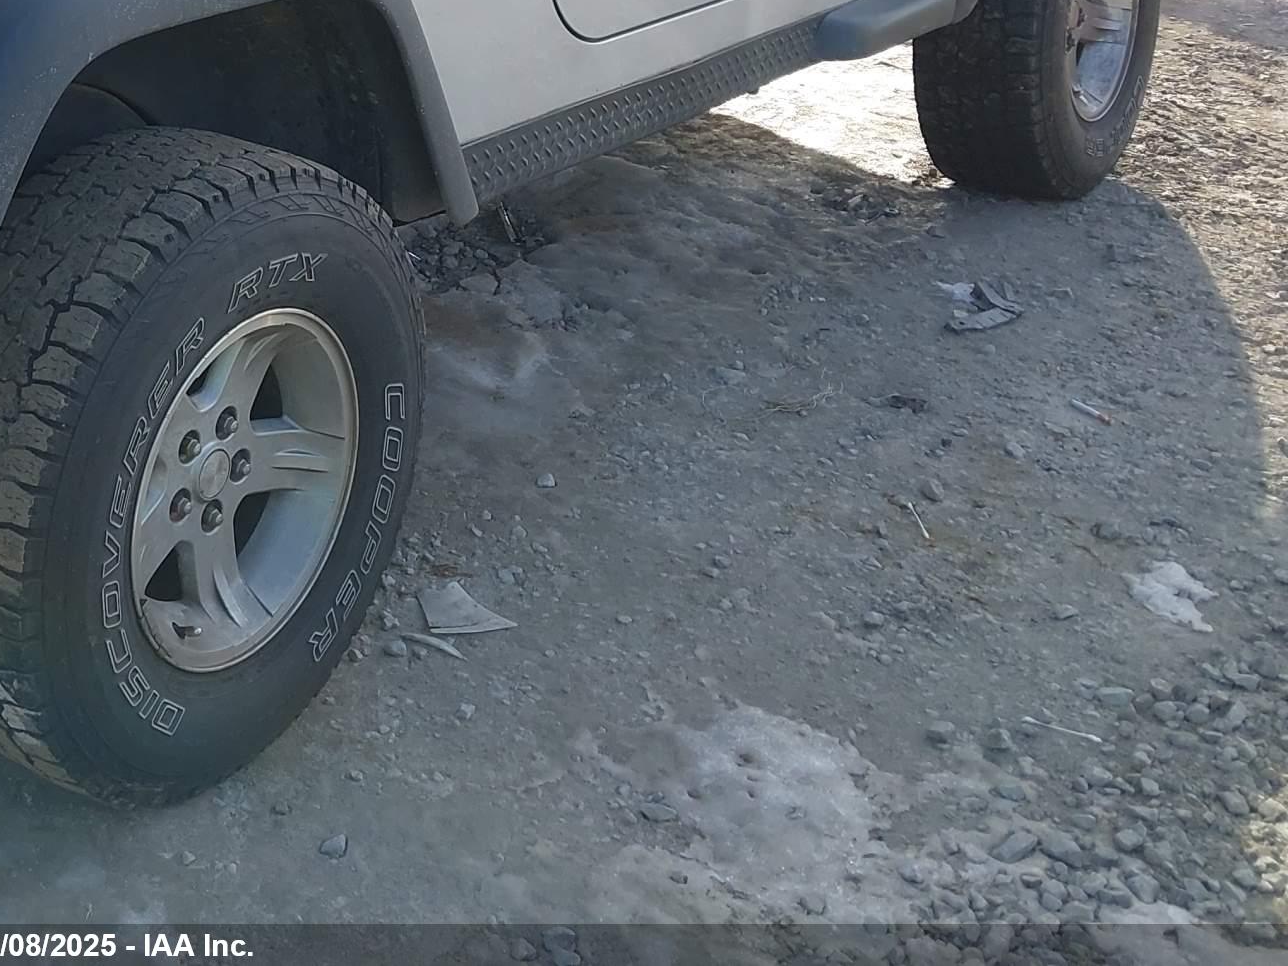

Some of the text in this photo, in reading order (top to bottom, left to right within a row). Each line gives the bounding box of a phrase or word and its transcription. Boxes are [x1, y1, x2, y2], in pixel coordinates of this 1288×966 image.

[102, 252, 328, 736] DISCOVERER RTX
[308, 383, 406, 663] COOPER
